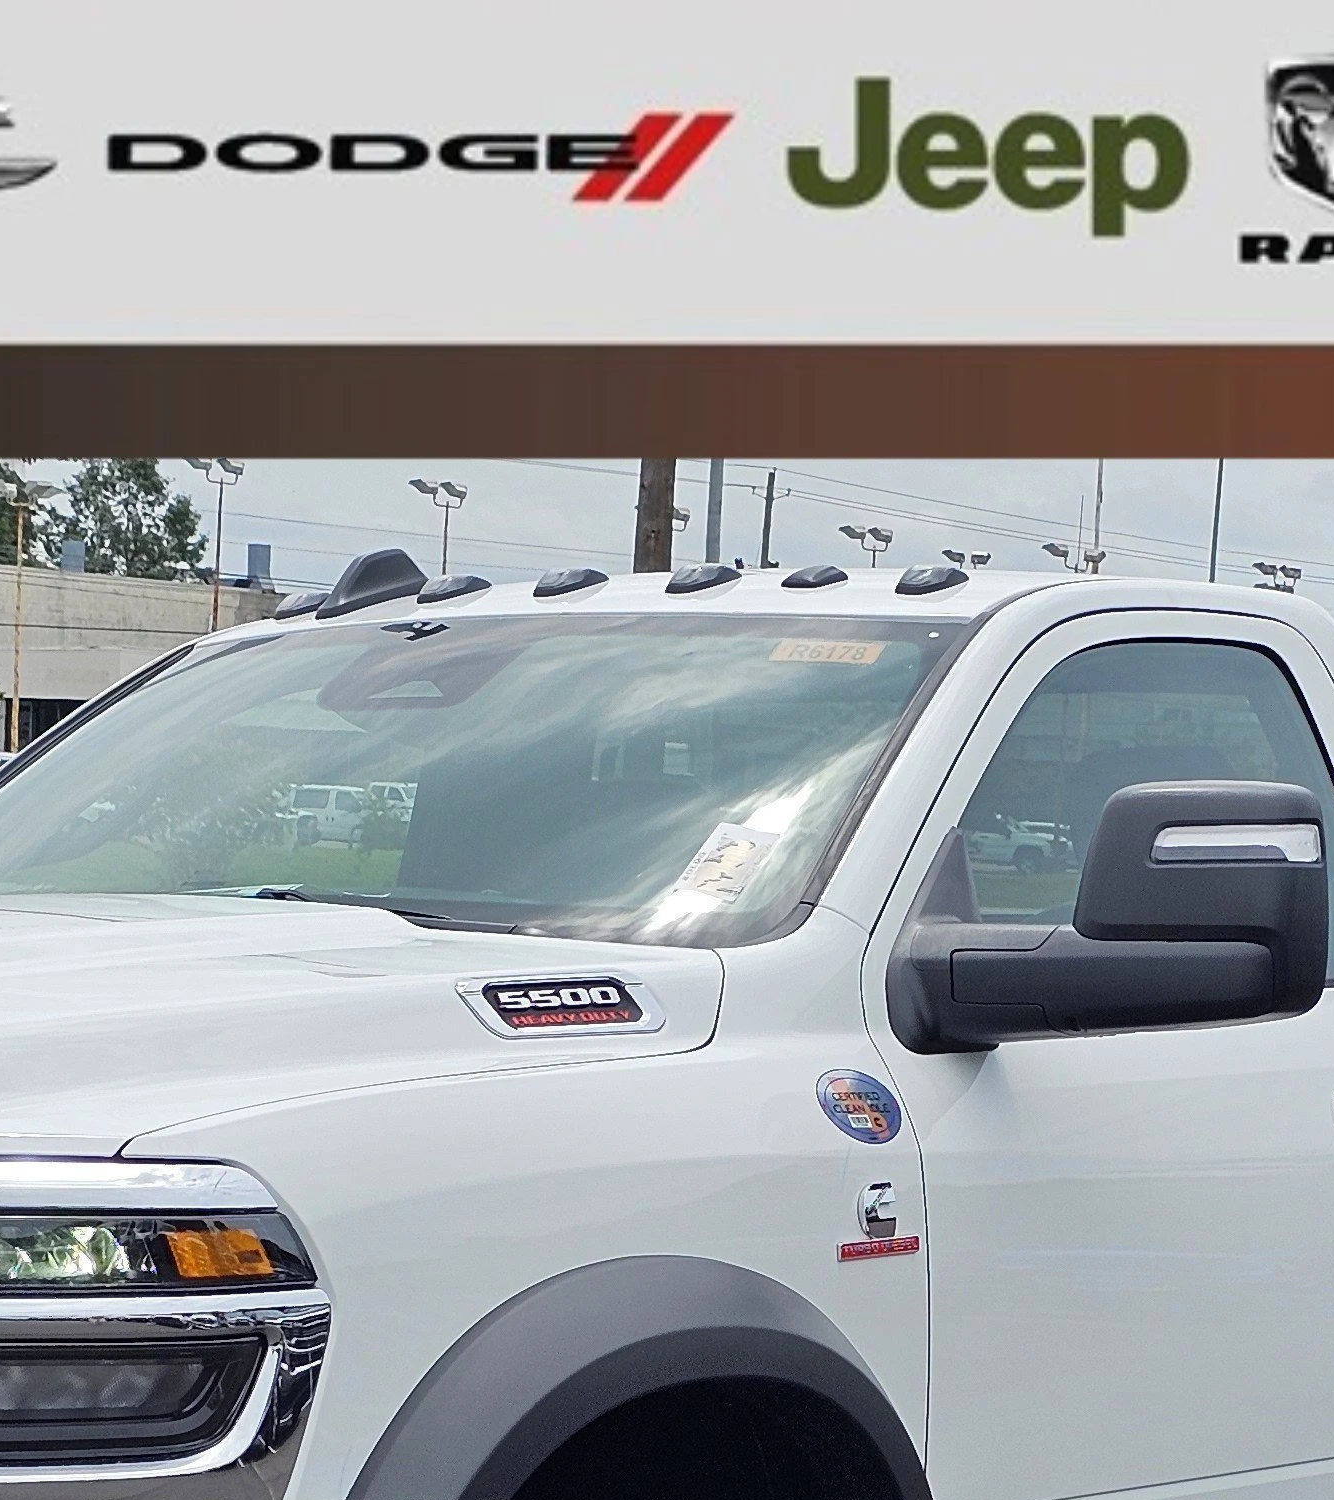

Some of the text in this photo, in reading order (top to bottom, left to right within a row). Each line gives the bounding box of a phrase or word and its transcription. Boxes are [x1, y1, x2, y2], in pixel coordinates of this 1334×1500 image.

[787, 643, 867, 661] R6178
[496, 985, 621, 1010] 5500
[511, 1009, 630, 1026] HEAVY DUTY
